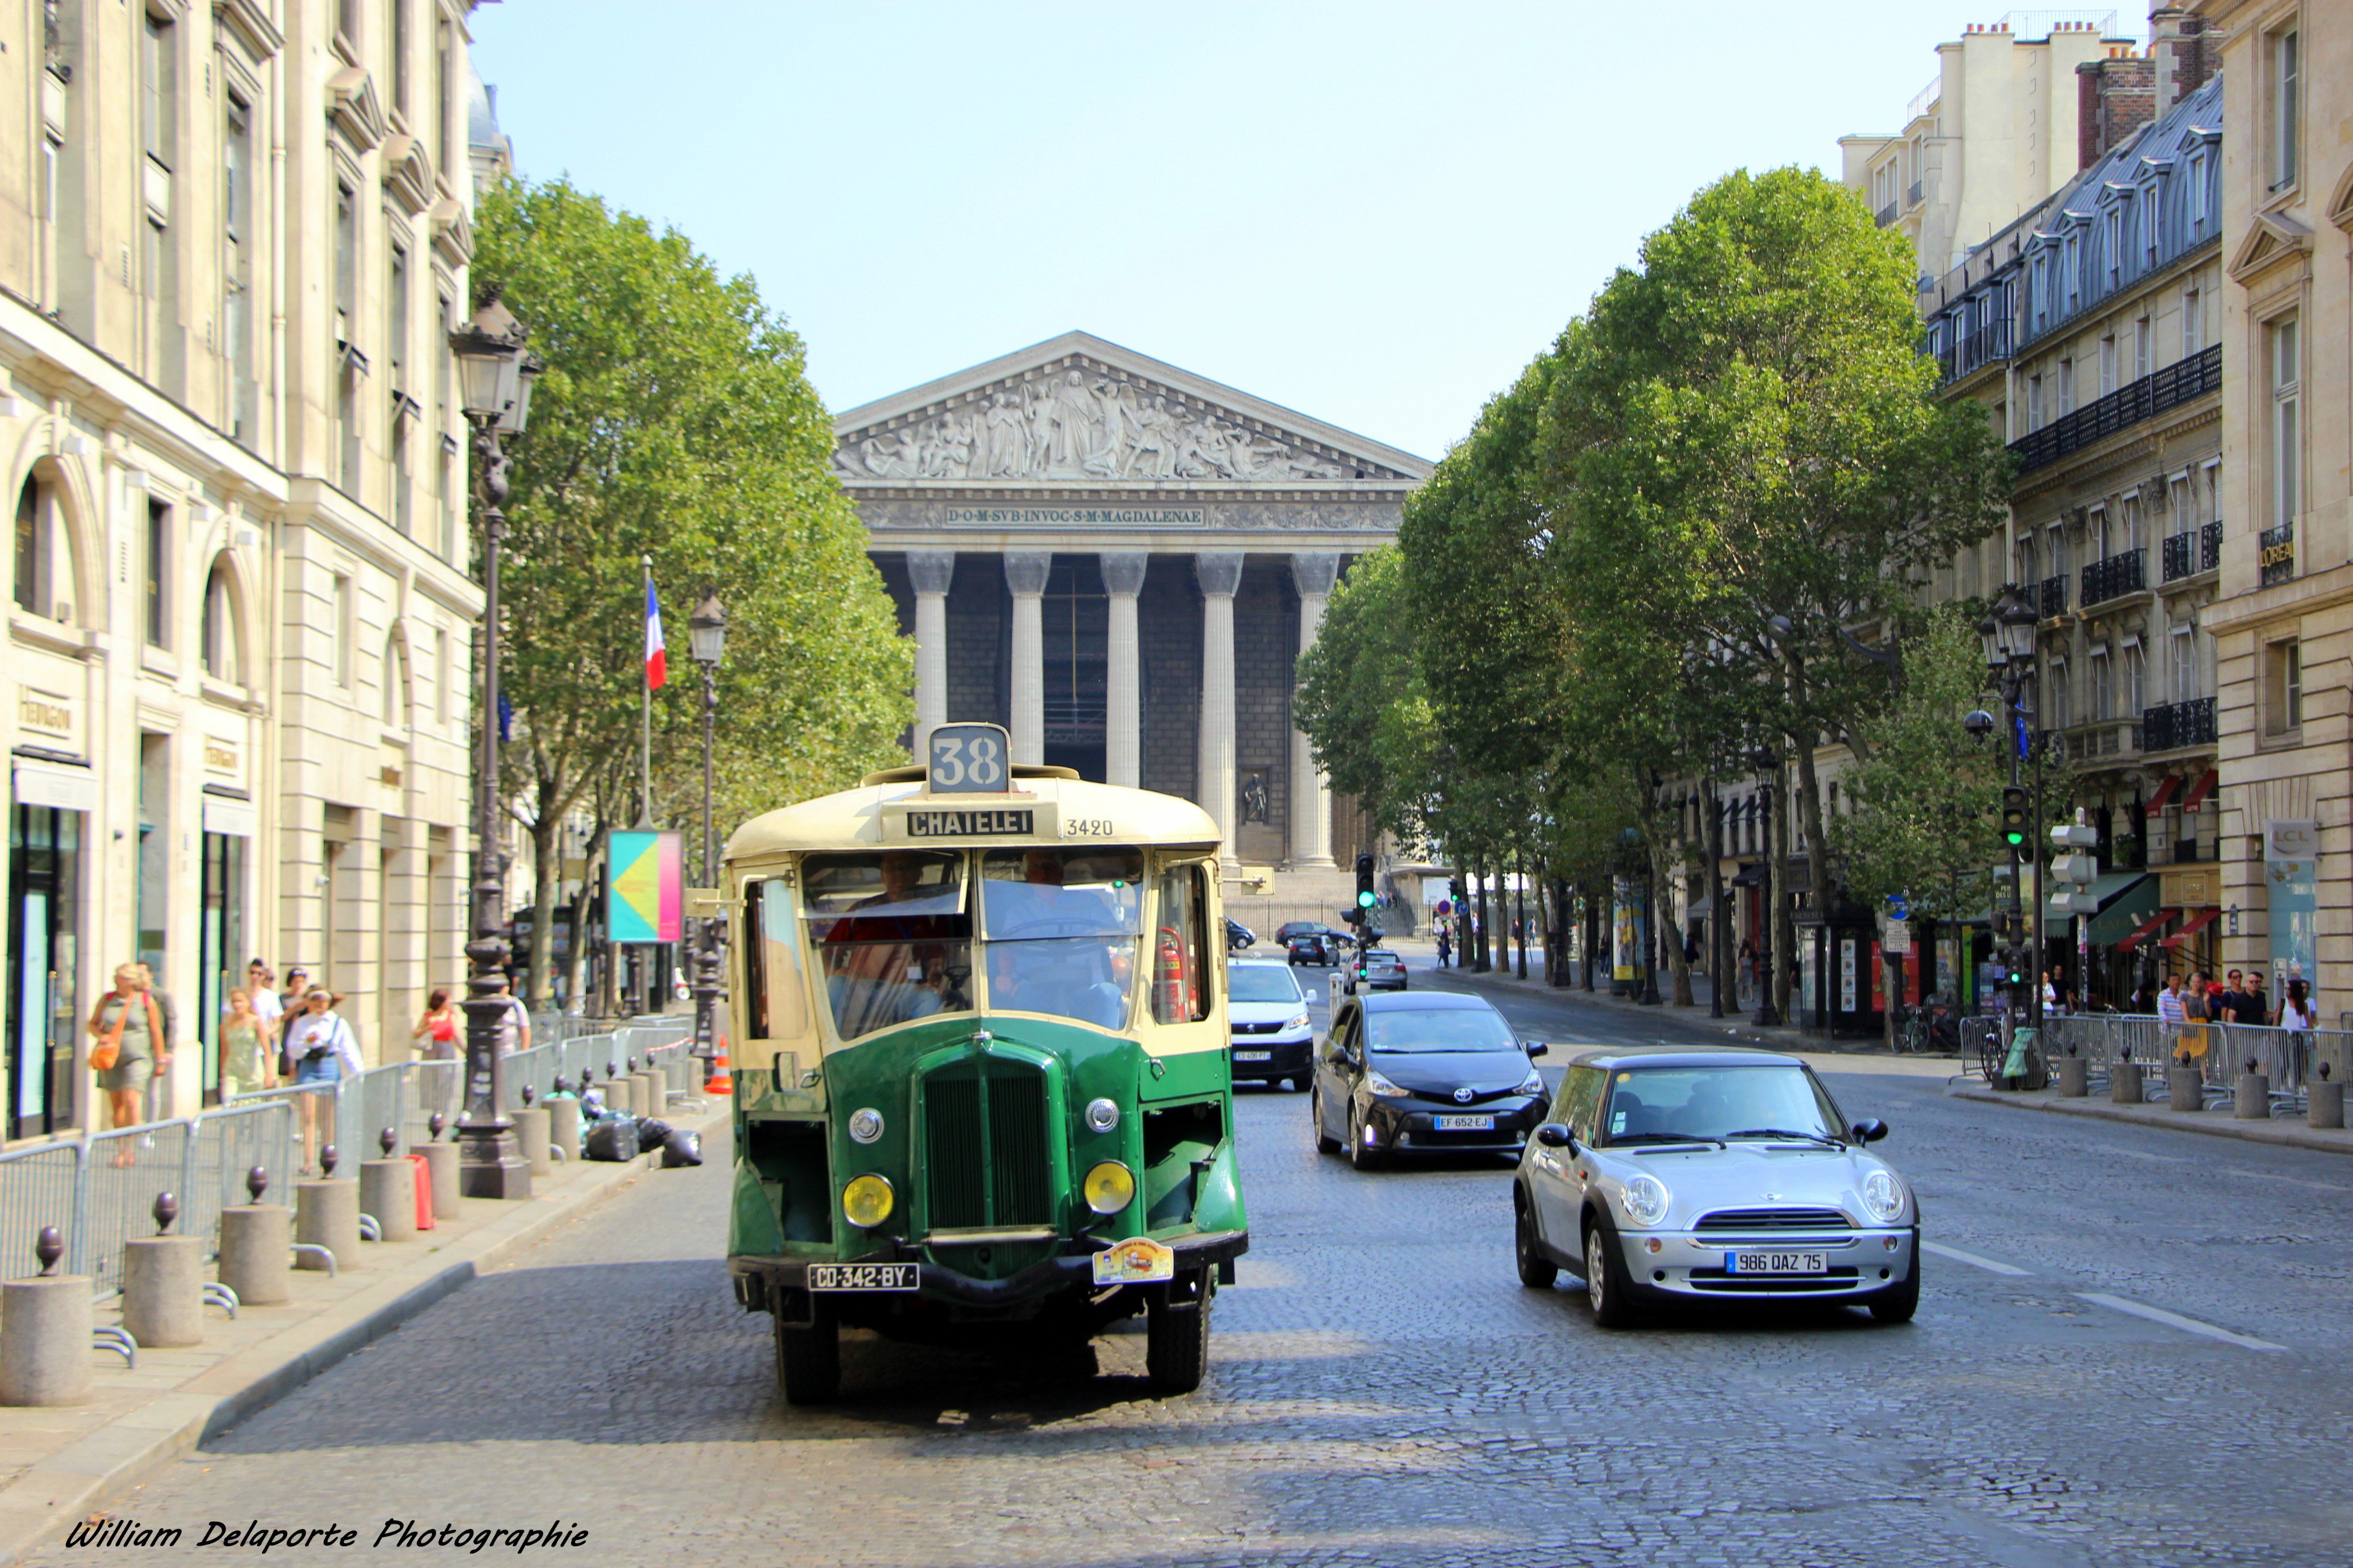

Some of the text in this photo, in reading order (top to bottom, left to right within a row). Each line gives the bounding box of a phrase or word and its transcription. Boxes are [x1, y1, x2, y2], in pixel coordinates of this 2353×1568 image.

[932, 737, 1000, 786] 38
[1067, 820, 1113, 836] 3420
[2274, 830, 2309, 842] LCL
[1739, 1254, 1820, 1270] 986 QAZ 75
